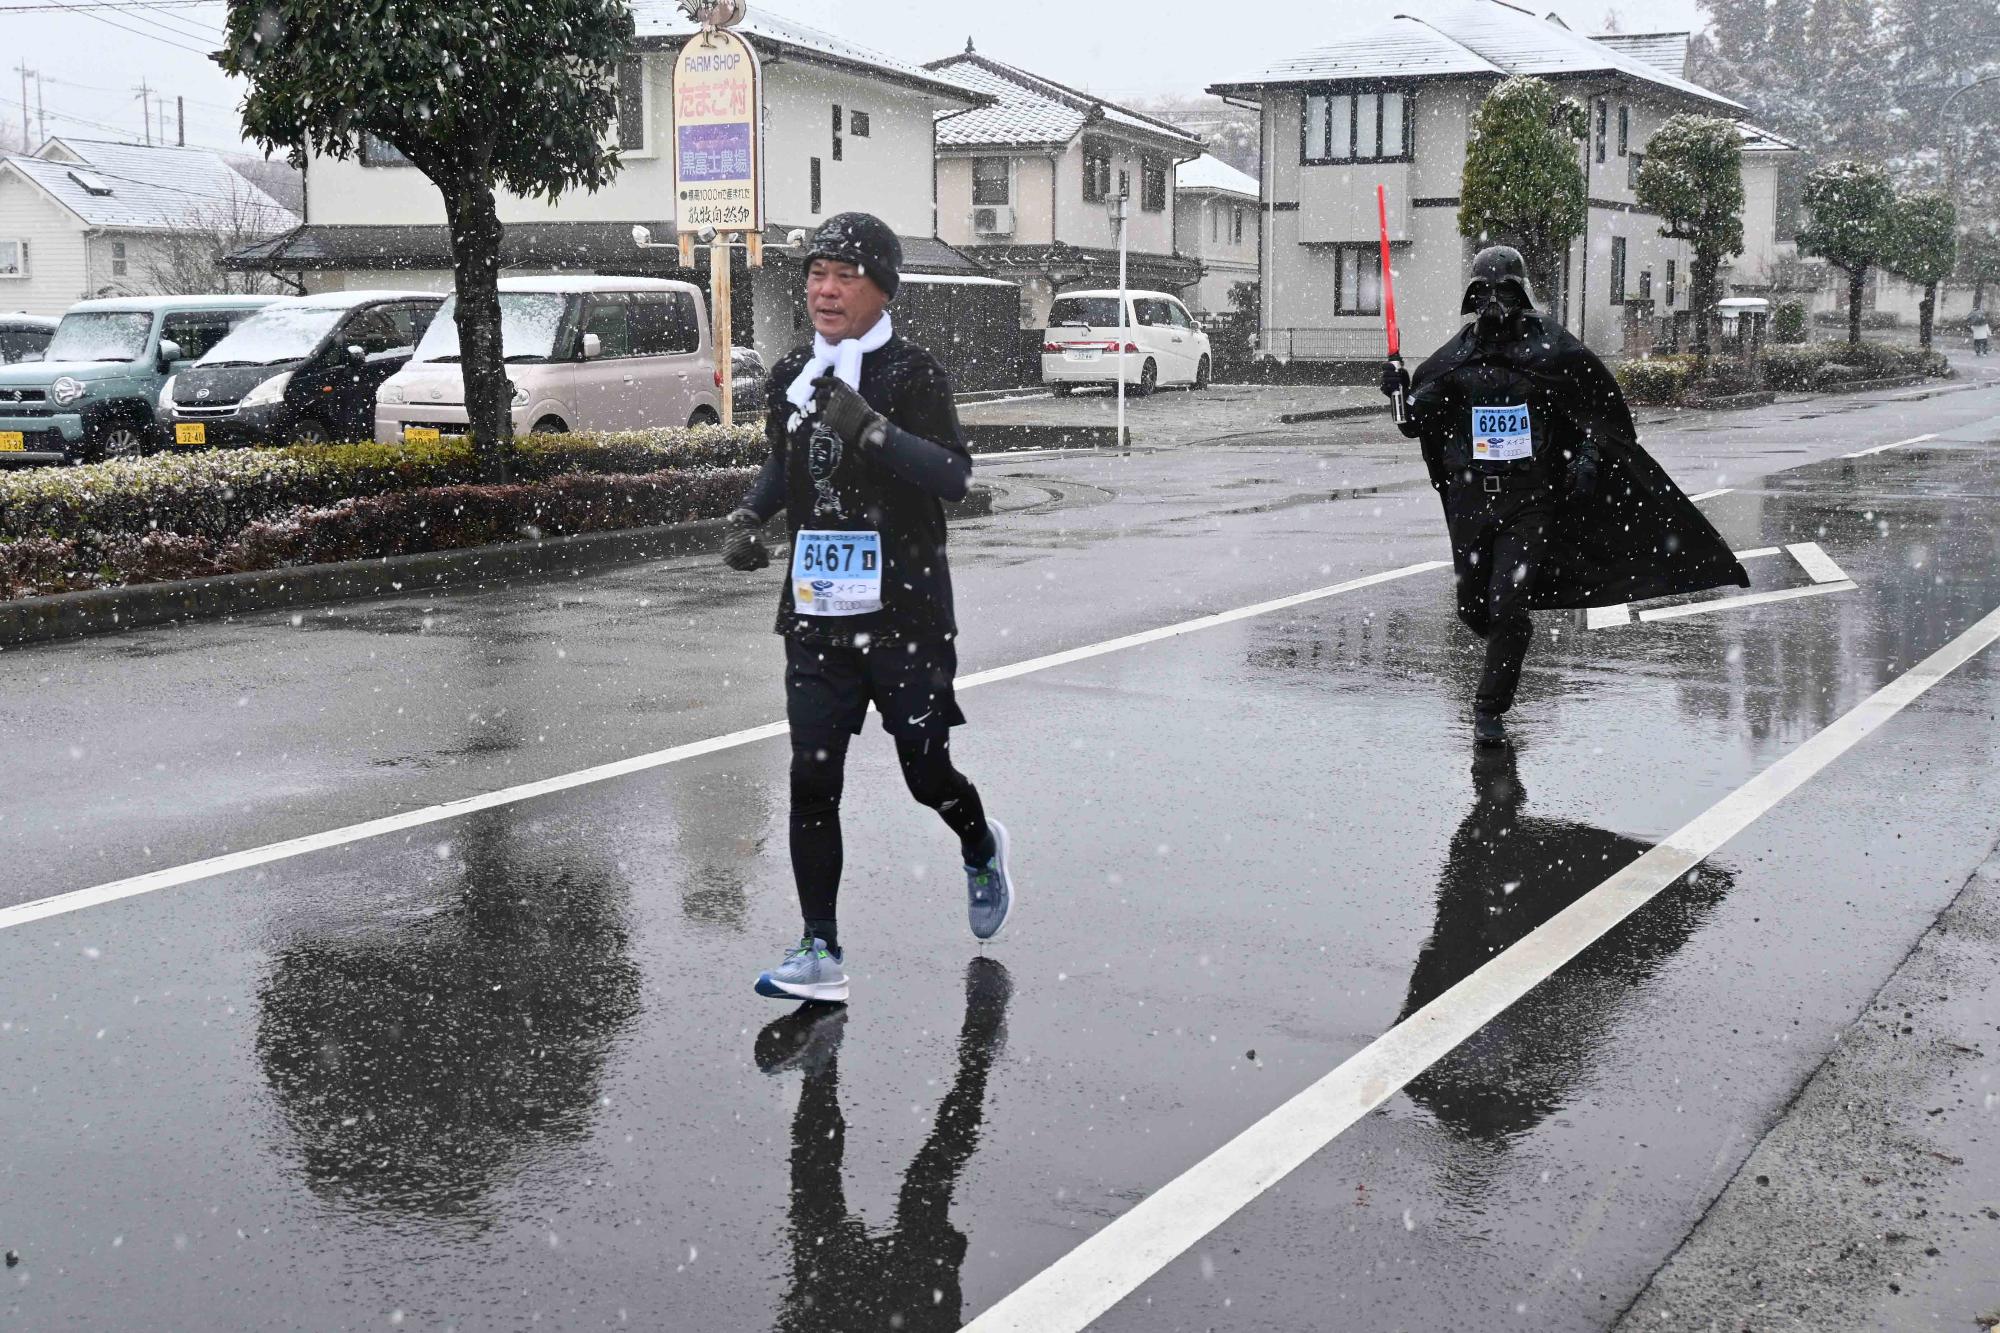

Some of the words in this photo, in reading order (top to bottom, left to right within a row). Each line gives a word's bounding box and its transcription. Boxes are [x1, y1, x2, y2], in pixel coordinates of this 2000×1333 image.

[684, 56, 711, 73] FARM
[713, 53, 741, 71] SHOP
[679, 78, 747, 118] たまご村
[682, 149, 747, 175] 黒富士農場
[1479, 414, 1517, 433] 6262
